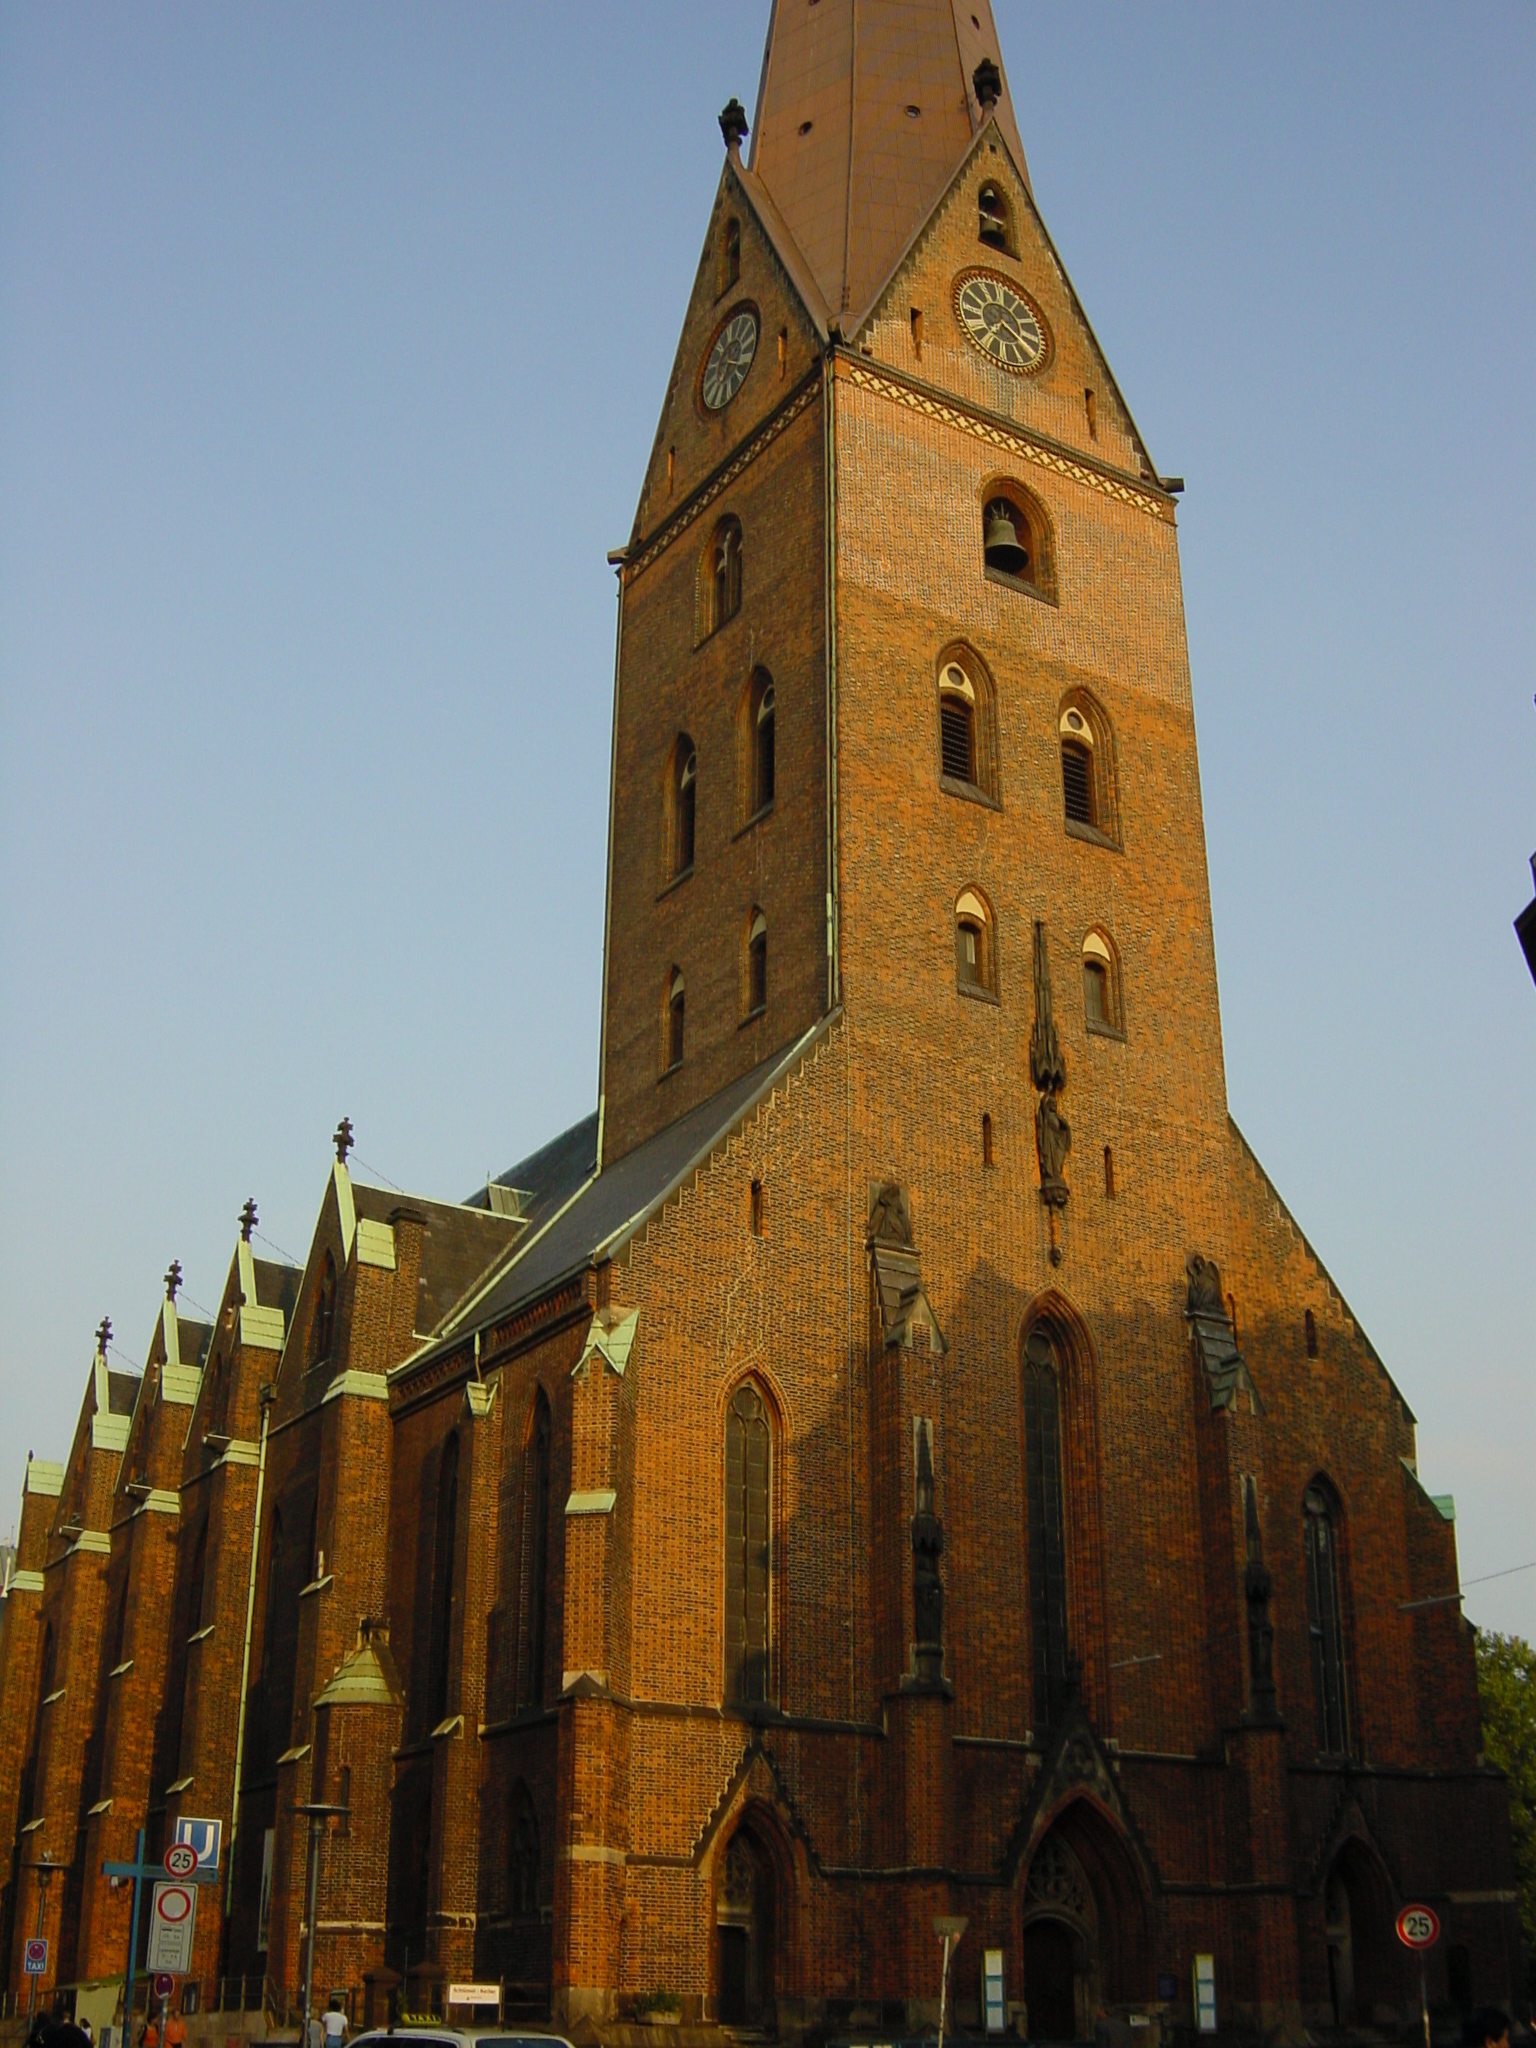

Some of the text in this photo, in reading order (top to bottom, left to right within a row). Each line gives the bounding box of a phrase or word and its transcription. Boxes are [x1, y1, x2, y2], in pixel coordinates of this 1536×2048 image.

[184, 1823, 214, 1862] U
[171, 1852, 192, 1869] 25
[1407, 1916, 1430, 1936] 25
[27, 1962, 45, 1971] TAXI
